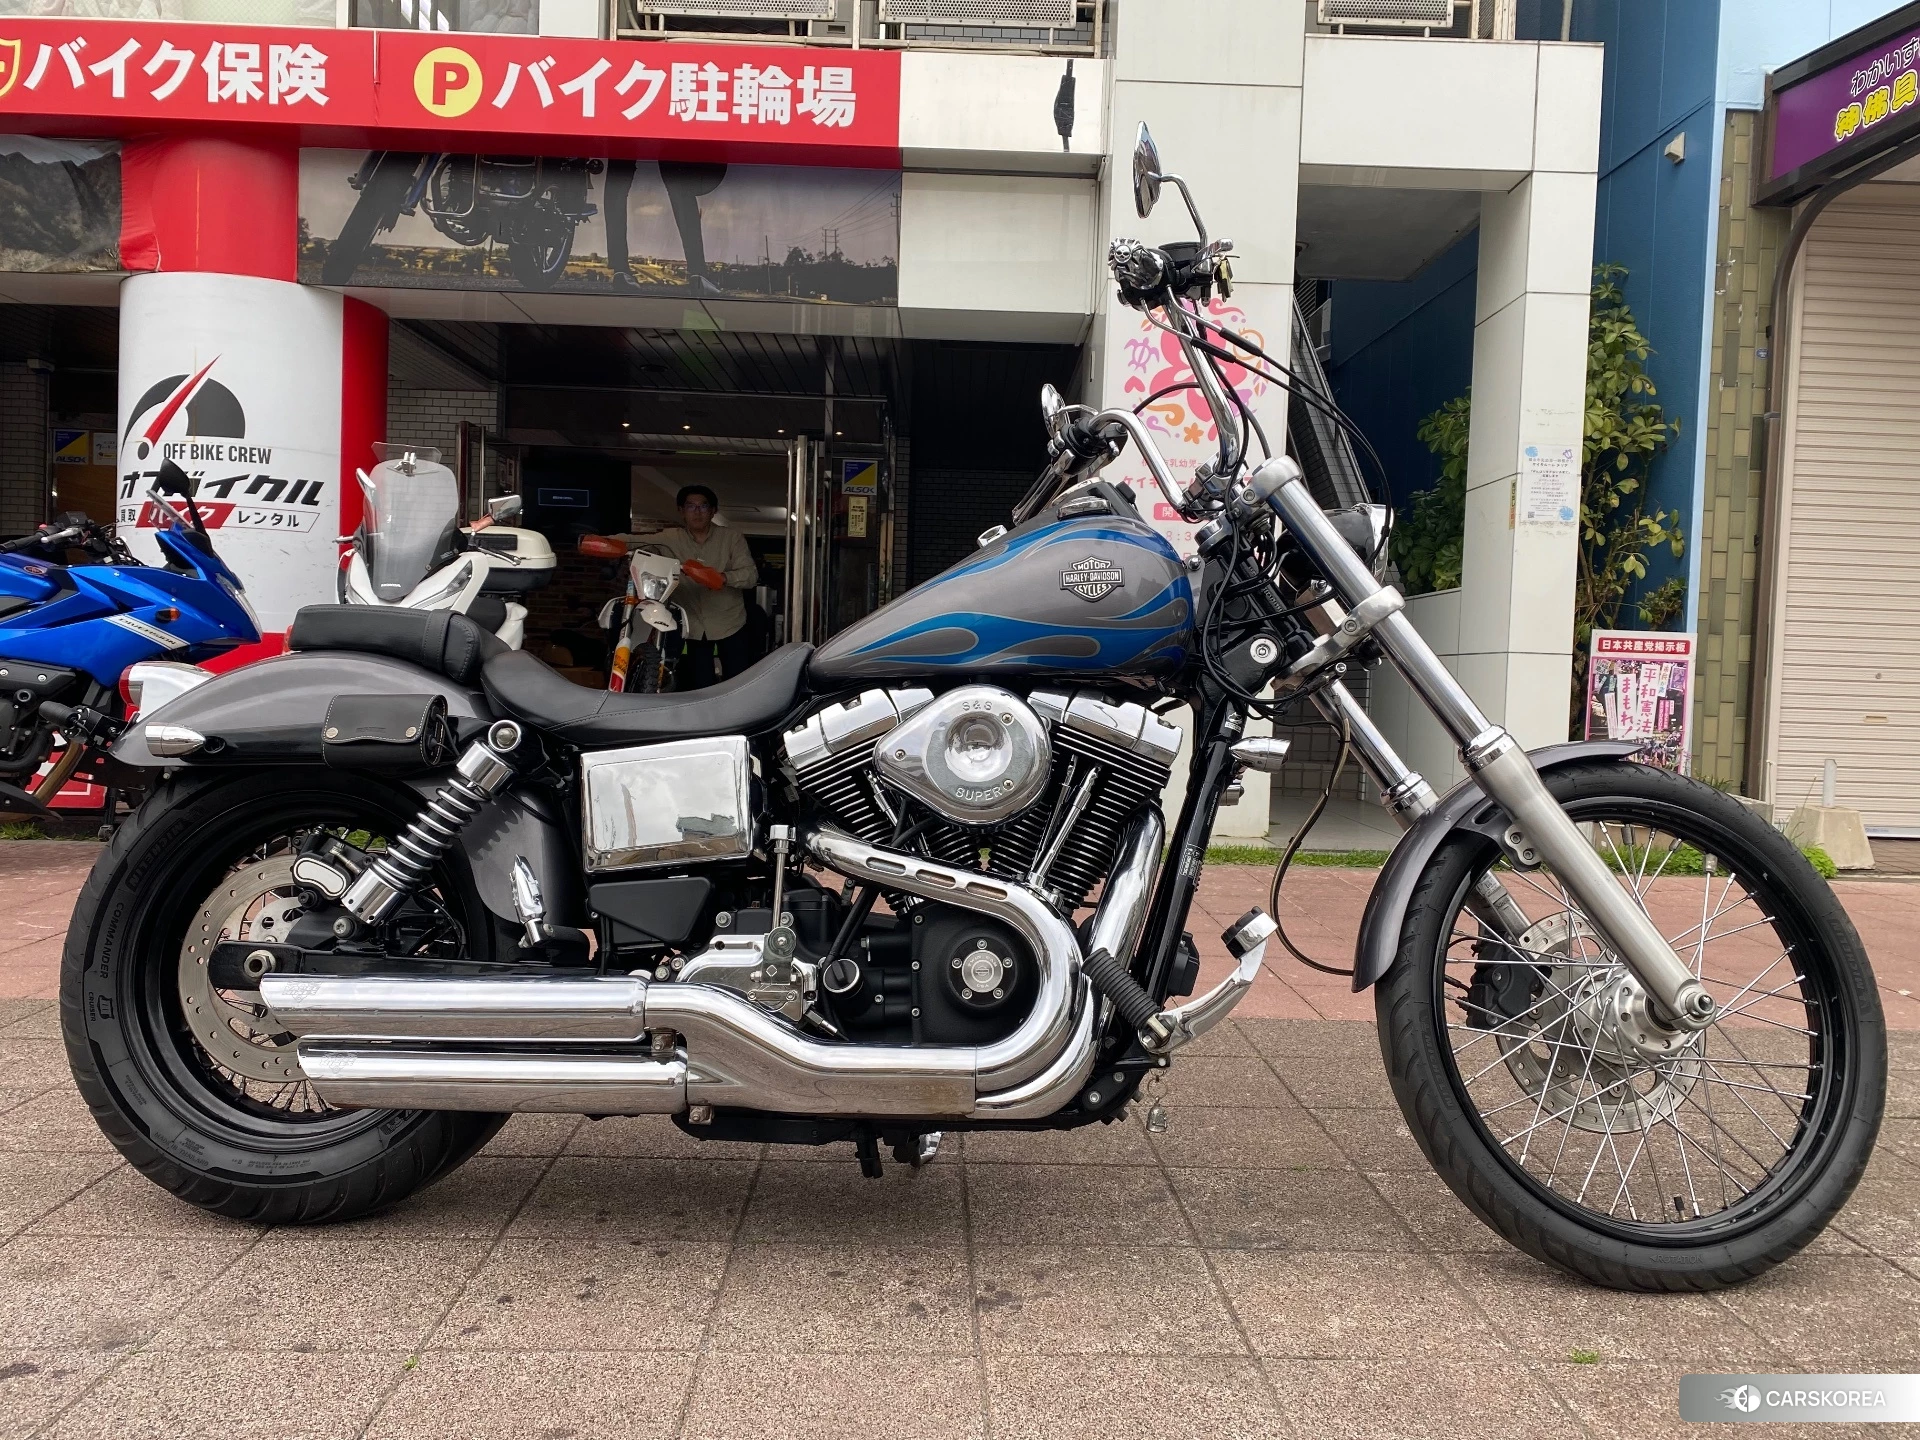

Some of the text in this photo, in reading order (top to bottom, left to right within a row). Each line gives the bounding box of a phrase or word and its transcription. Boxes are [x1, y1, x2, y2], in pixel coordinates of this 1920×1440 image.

[23, 36, 330, 106] バイク保険
[1850, 36, 1920, 97] わかいず
[492, 55, 856, 127] バイク駐輪場
[163, 443, 272, 465] OFF BIKE CREW
[844, 486, 875, 494] ALSOK
[120, 508, 136, 522] 買取
[238, 510, 300, 528] レンタル
[1077, 559, 1106, 571] MOTOR
[1065, 571, 1119, 583] HARLEY-DAVIDSON
[1078, 583, 1107, 596] CYCLES
[1602, 639, 1687, 653] 日本共産党掲示板
[1636, 667, 1657, 734] 平和憲法
[955, 786, 1003, 801] SUPER
[100, 902, 125, 979] COMMANDER
[88, 991, 96, 1022] CRUISER
[1657, 1253, 1704, 1264] ROTATION
